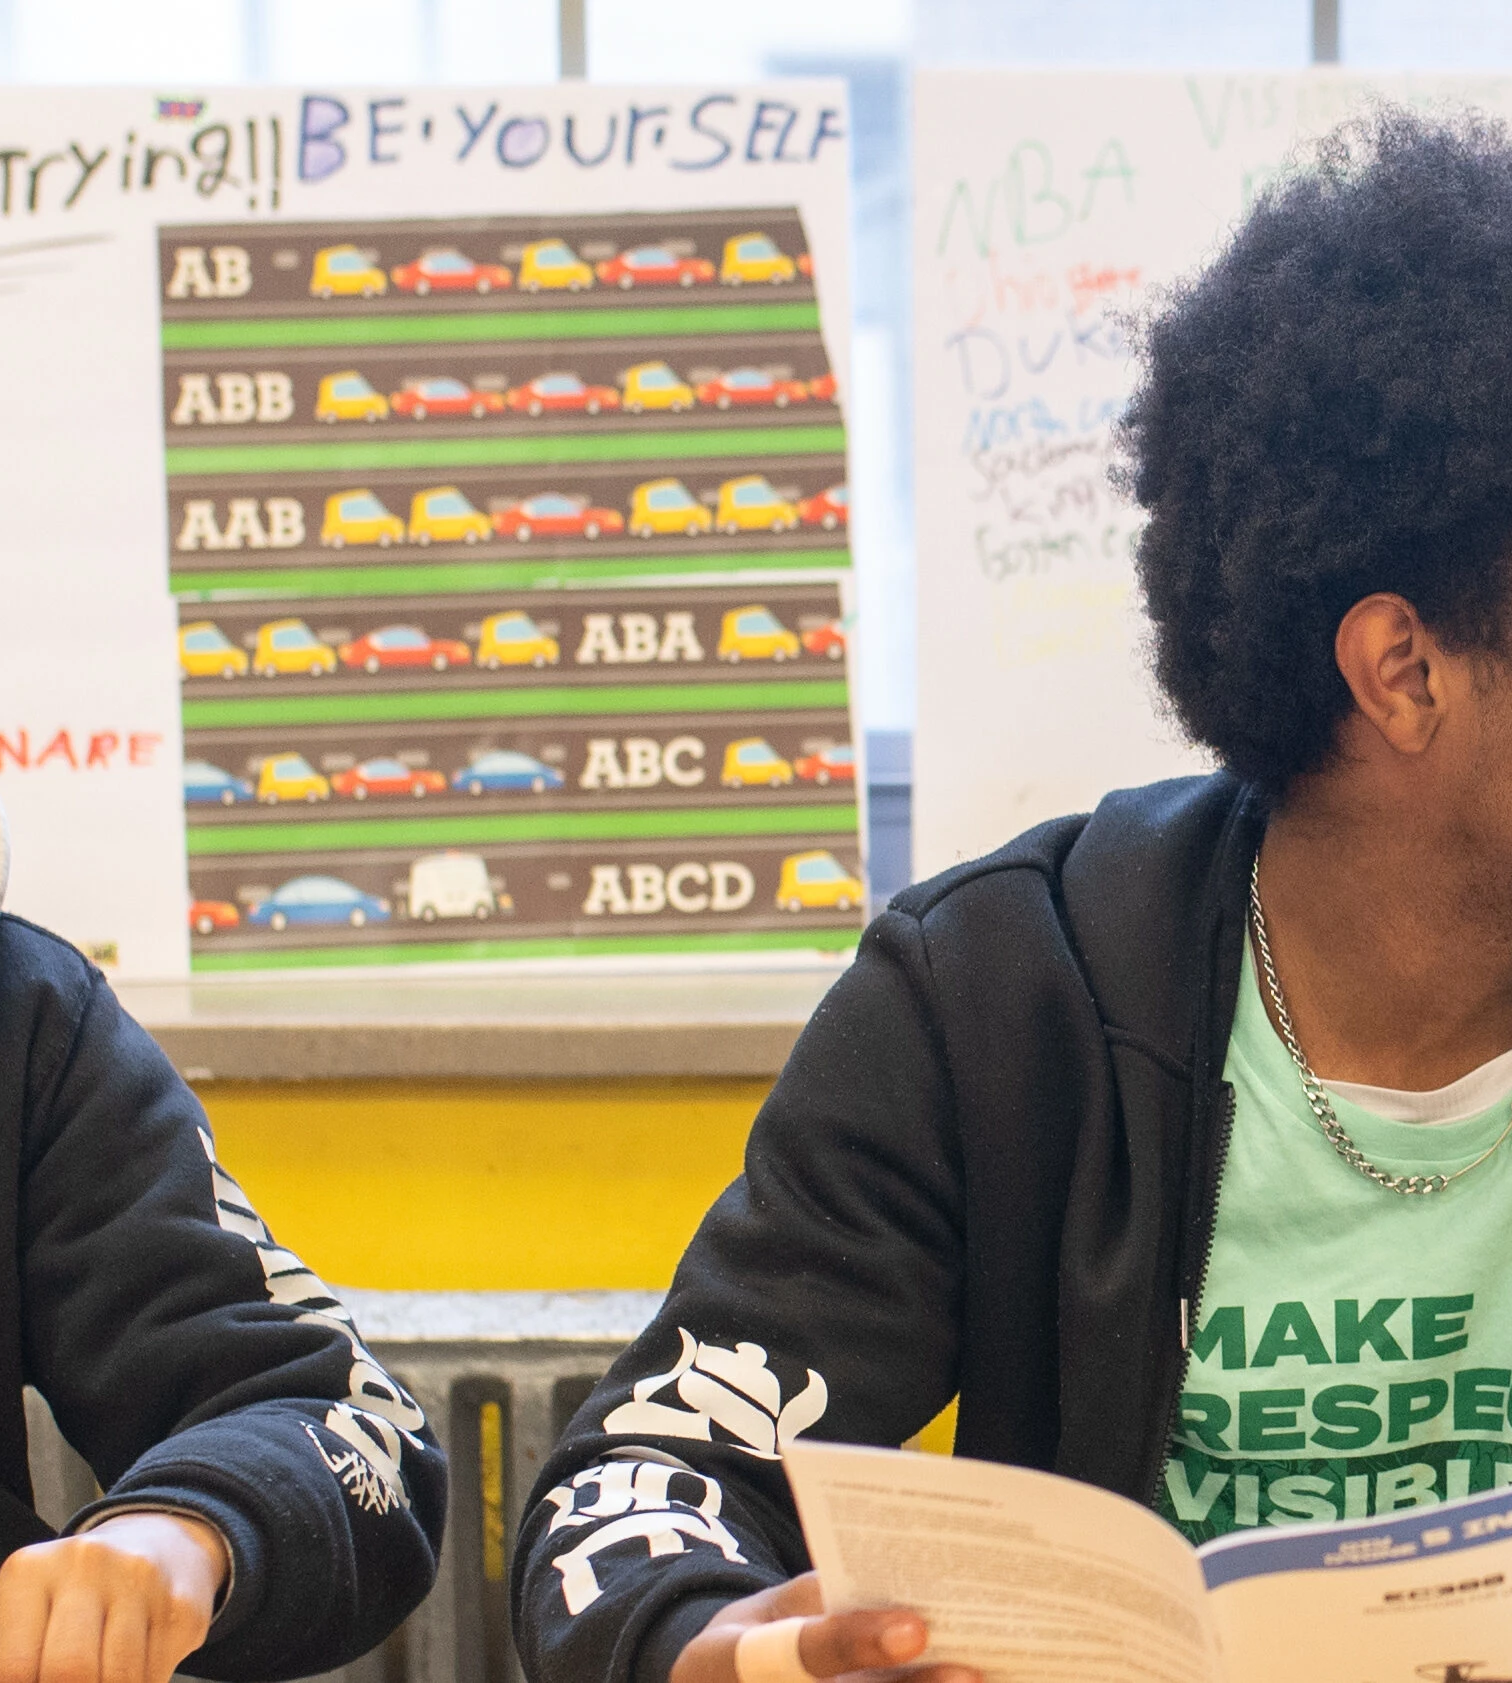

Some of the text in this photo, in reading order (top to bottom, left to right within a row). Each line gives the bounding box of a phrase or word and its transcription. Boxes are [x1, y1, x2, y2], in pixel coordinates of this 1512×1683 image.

[936, 138, 1139, 259] NBA
[168, 245, 253, 299] AB
[172, 371, 295, 424] ABB
[177, 499, 306, 550] AAB
[577, 612, 704, 664] ABA
[578, 736, 706, 789] ABC
[583, 862, 755, 916] ABCD
[1189, 1293, 1475, 1371] MAKE
